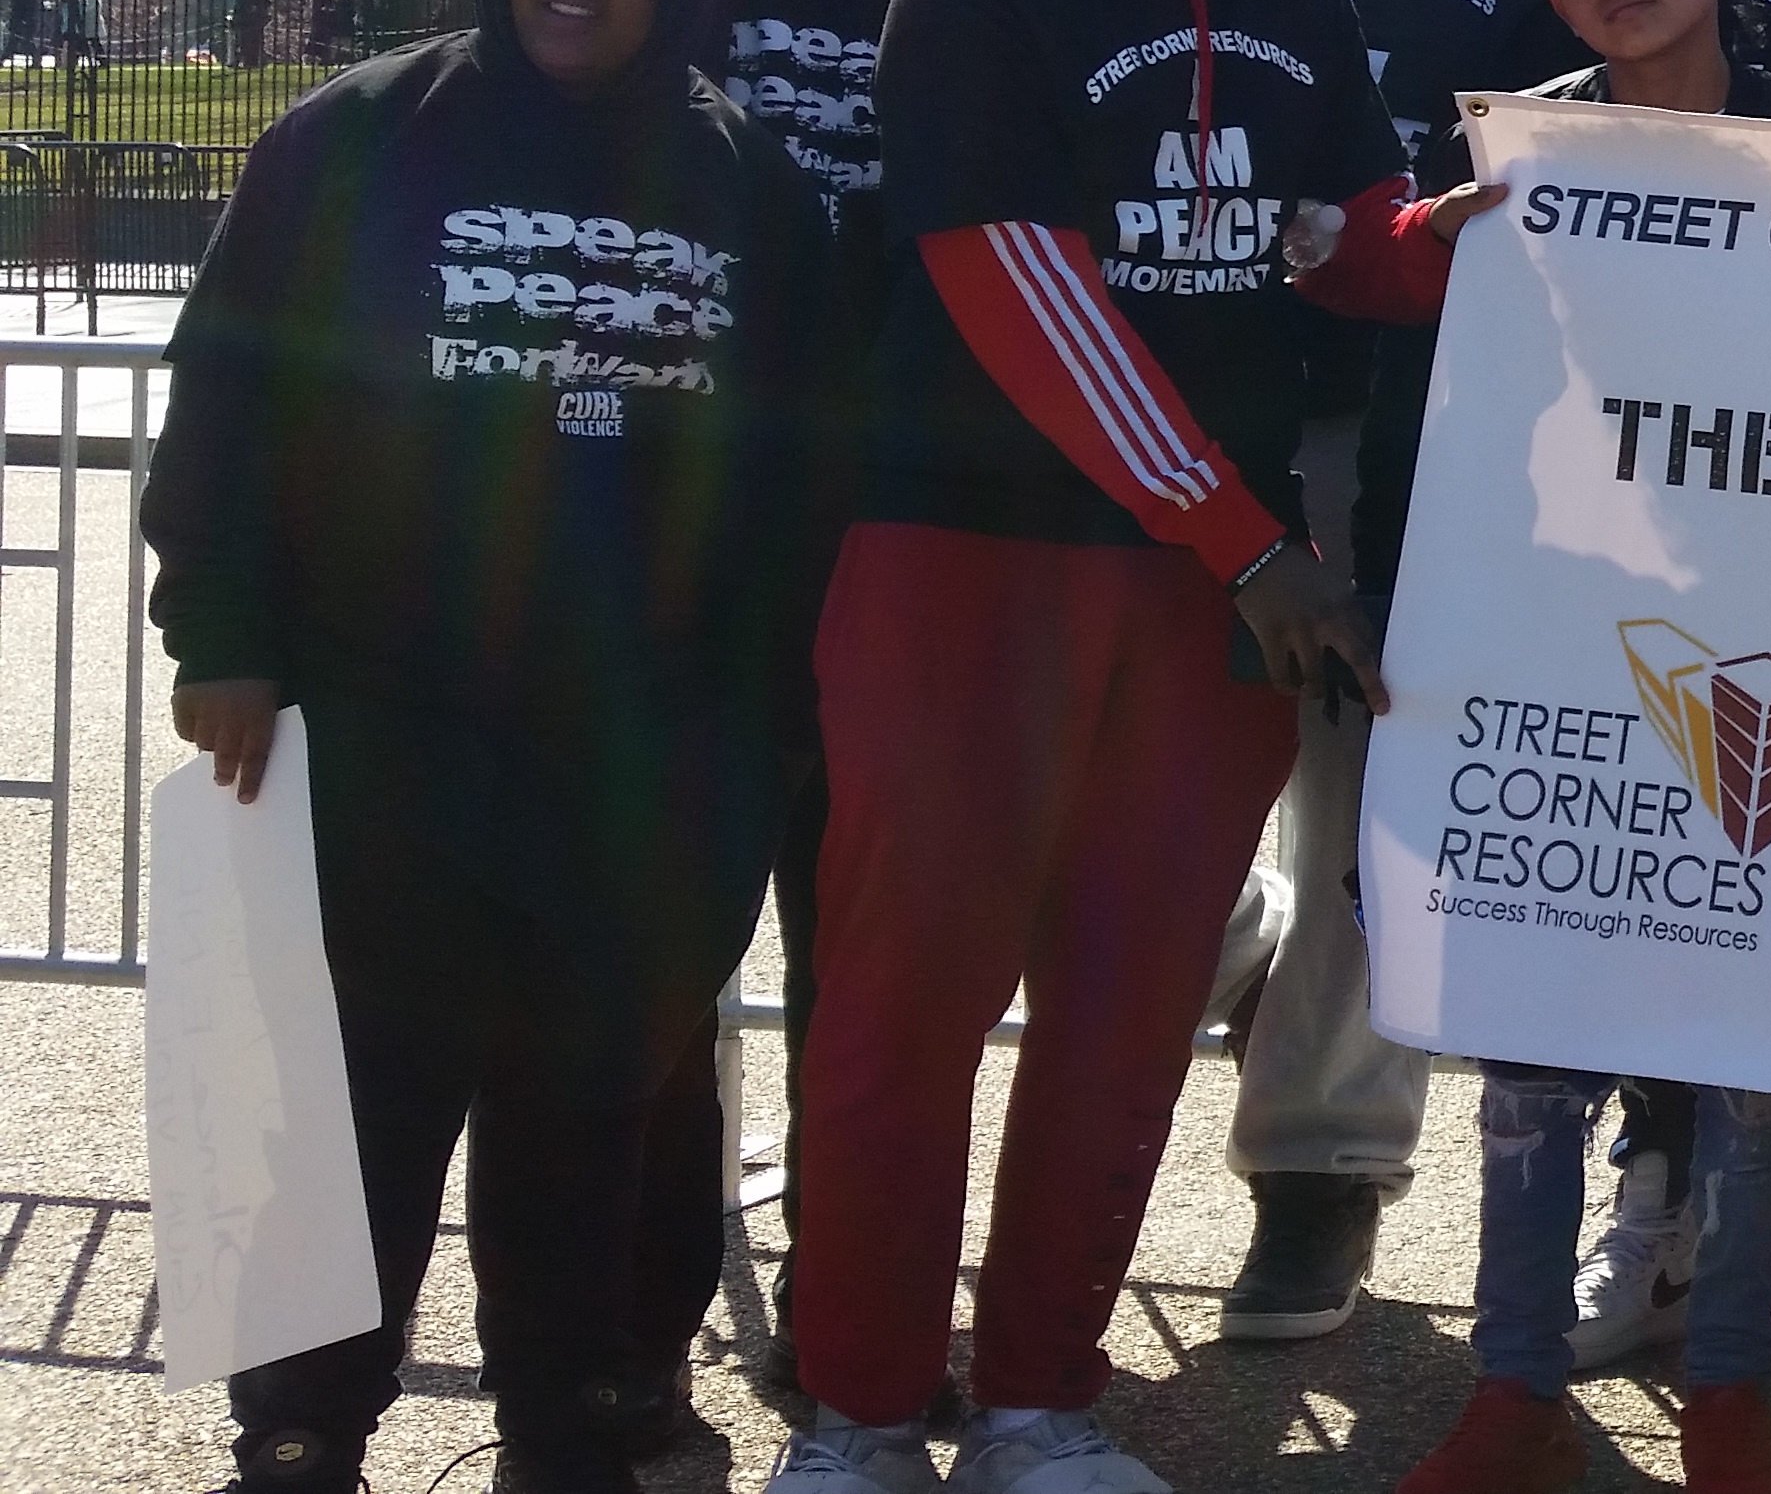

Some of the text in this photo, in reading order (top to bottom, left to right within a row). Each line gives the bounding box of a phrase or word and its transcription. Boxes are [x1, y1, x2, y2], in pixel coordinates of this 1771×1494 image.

[1208, 30, 1314, 86] RESOURCES
[1154, 126, 1253, 190] AM
[1521, 183, 1755, 250] STREET
[556, 390, 623, 420] CURE
[556, 420, 623, 438] VIOLENCE
[1456, 695, 1640, 765] STREET
[1449, 762, 1693, 840] CORNER
[1434, 827, 1766, 916] RESOURCES
[1425, 888, 1758, 952] Success Through Resources
